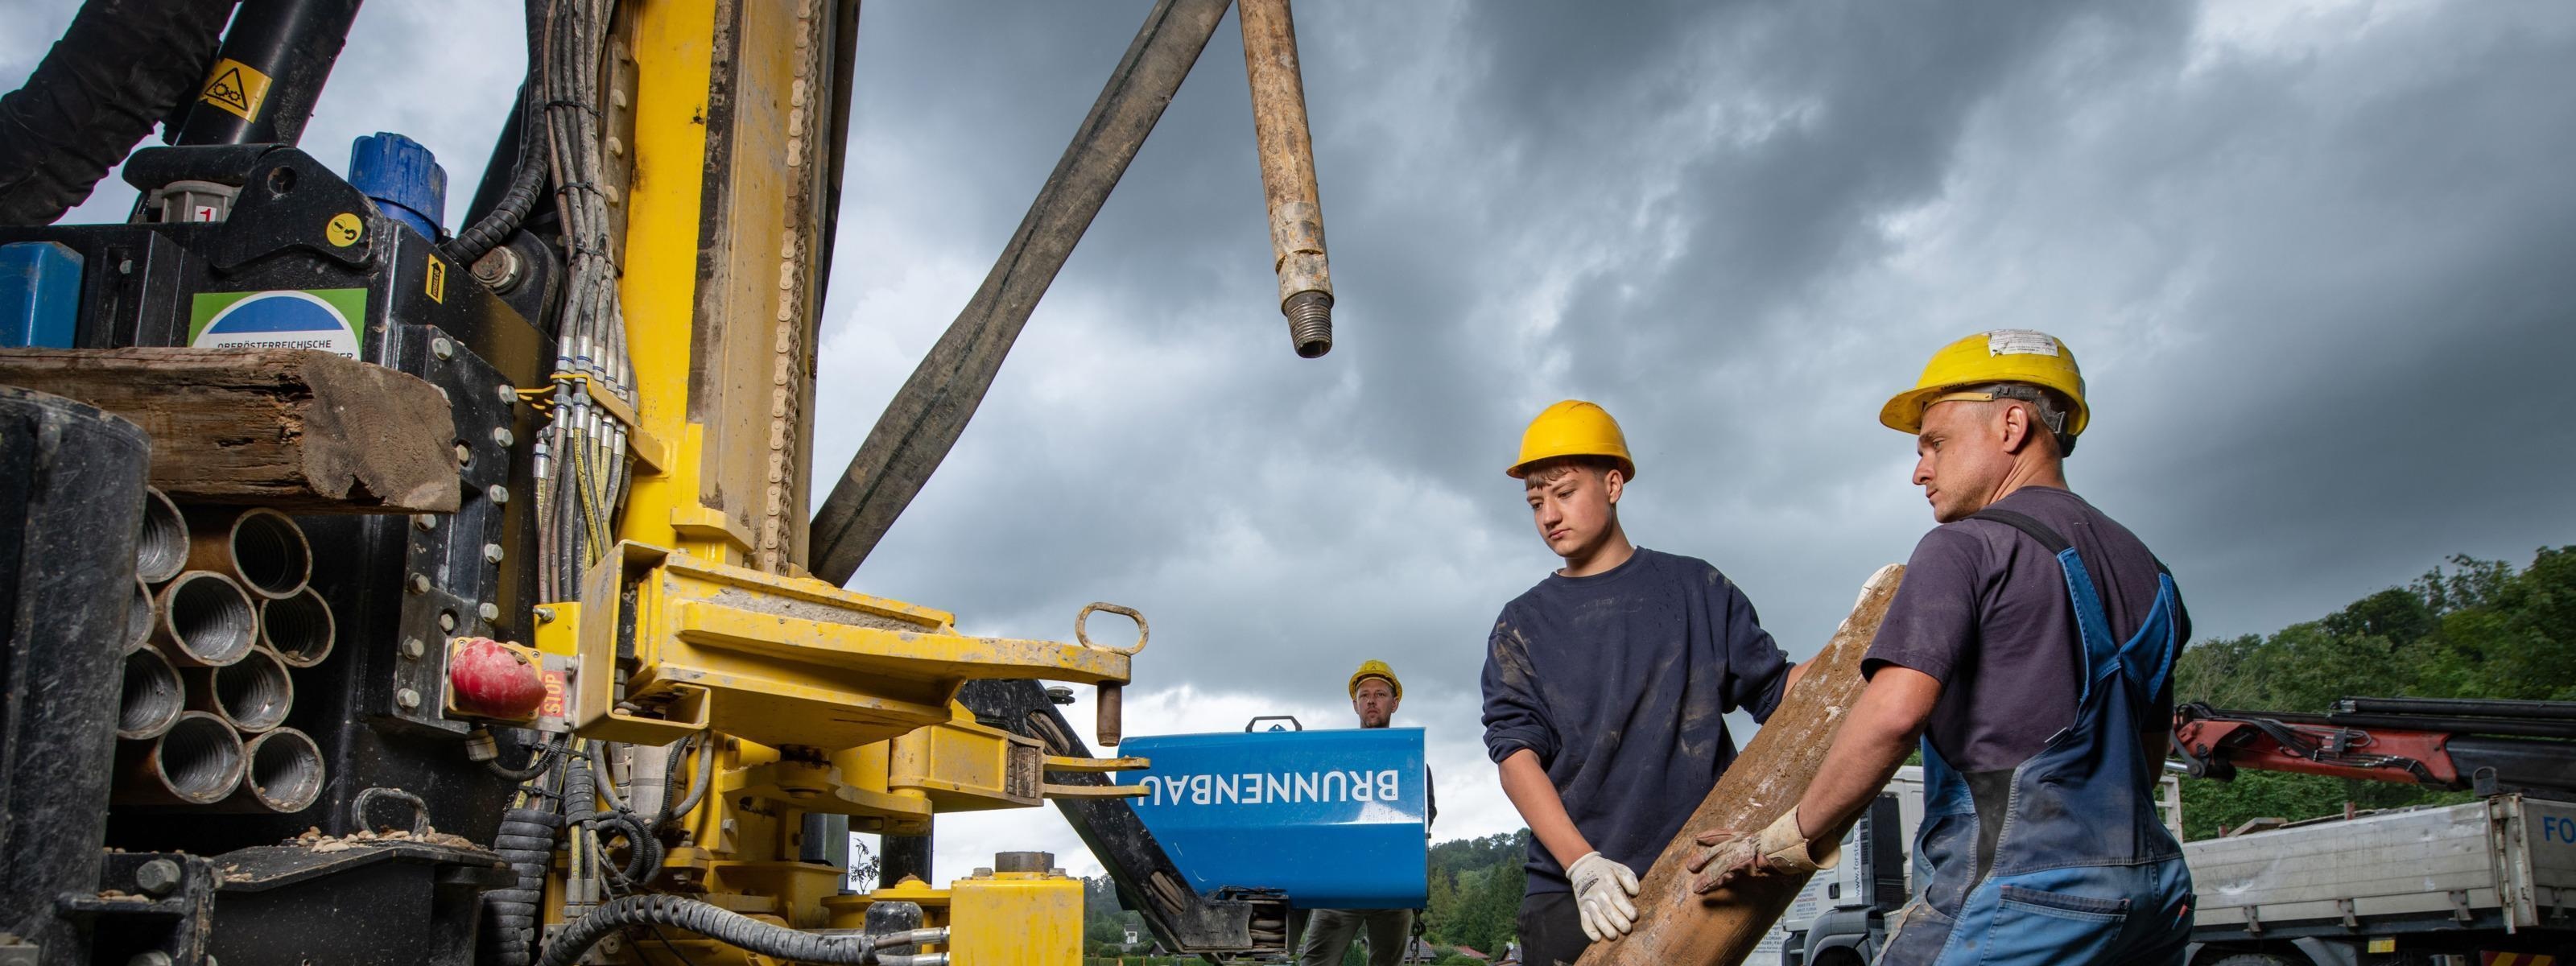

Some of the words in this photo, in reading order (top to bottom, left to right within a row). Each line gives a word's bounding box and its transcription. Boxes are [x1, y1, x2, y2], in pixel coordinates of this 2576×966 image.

[200, 208, 211, 222] 1
[217, 340, 332, 349] OBERÖSTERREICHISCHE
[543, 673, 562, 714] STOP
[1137, 770, 1399, 806] BRUNNENBAU
[2543, 815, 2576, 844] FO
